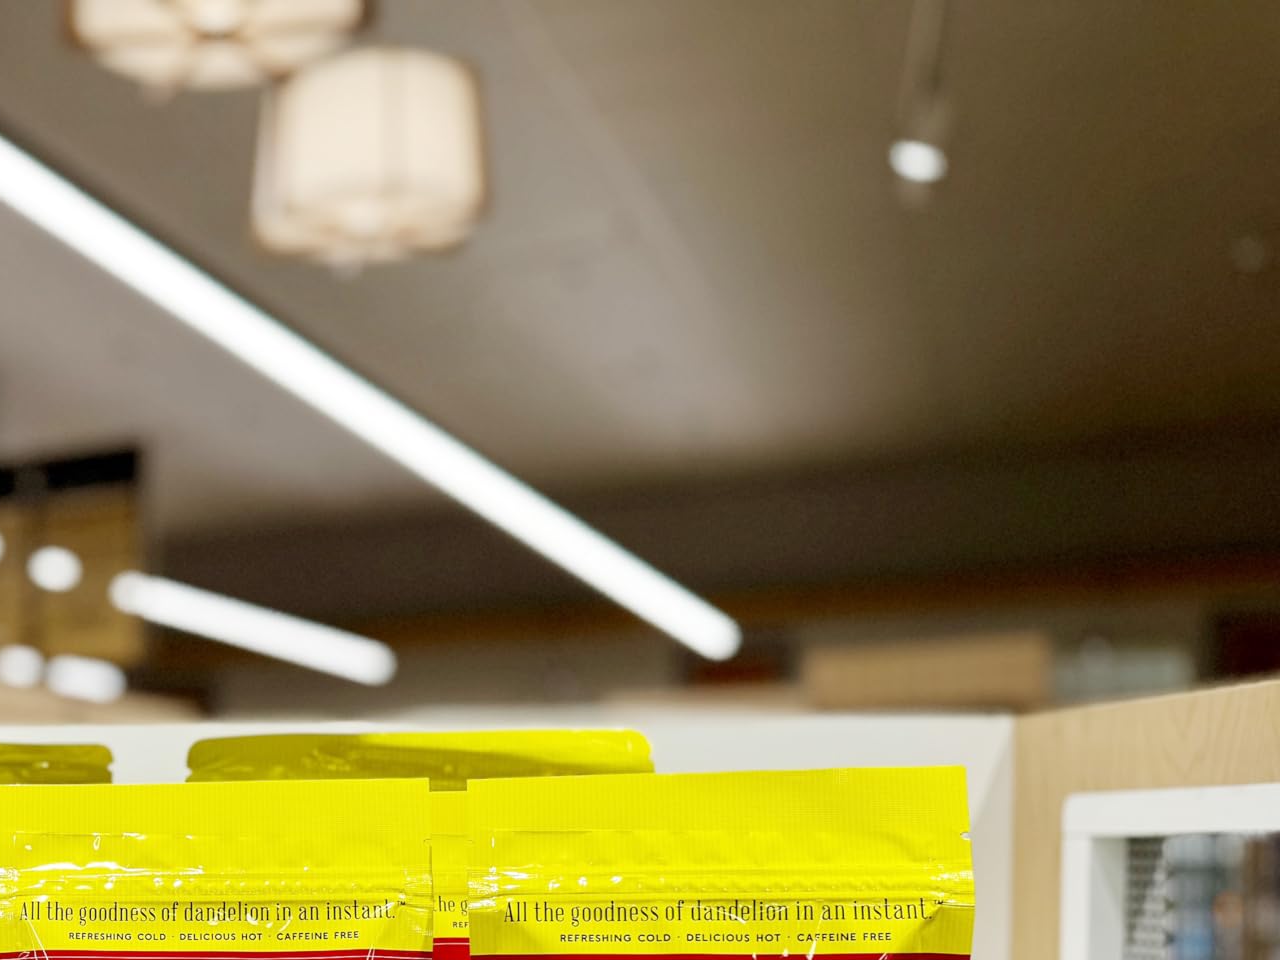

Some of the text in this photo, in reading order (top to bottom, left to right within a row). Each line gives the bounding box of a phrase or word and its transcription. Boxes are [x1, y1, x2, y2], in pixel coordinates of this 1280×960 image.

[20, 901, 40, 921] All
[47, 902, 73, 921] the
[80, 902, 156, 926] goodness
[162, 901, 178, 921] of
[185, 902, 269, 921] dandelion
[277, 903, 292, 920] in
[299, 906, 319, 920] an
[504, 901, 527, 922] All
[534, 901, 564, 922] the
[571, 901, 658, 927] goodness
[665, 900, 684, 922] of
[692, 900, 788, 921] dandelion
[797, 901, 814, 920] in
[822, 905, 845, 920] an
[277, 932, 328, 940] CAFFEINE
[334, 931, 358, 939] FREE
[560, 932, 891, 942] REFRESHING COLD DELICIOUS HOT CAFFEINE FREE
